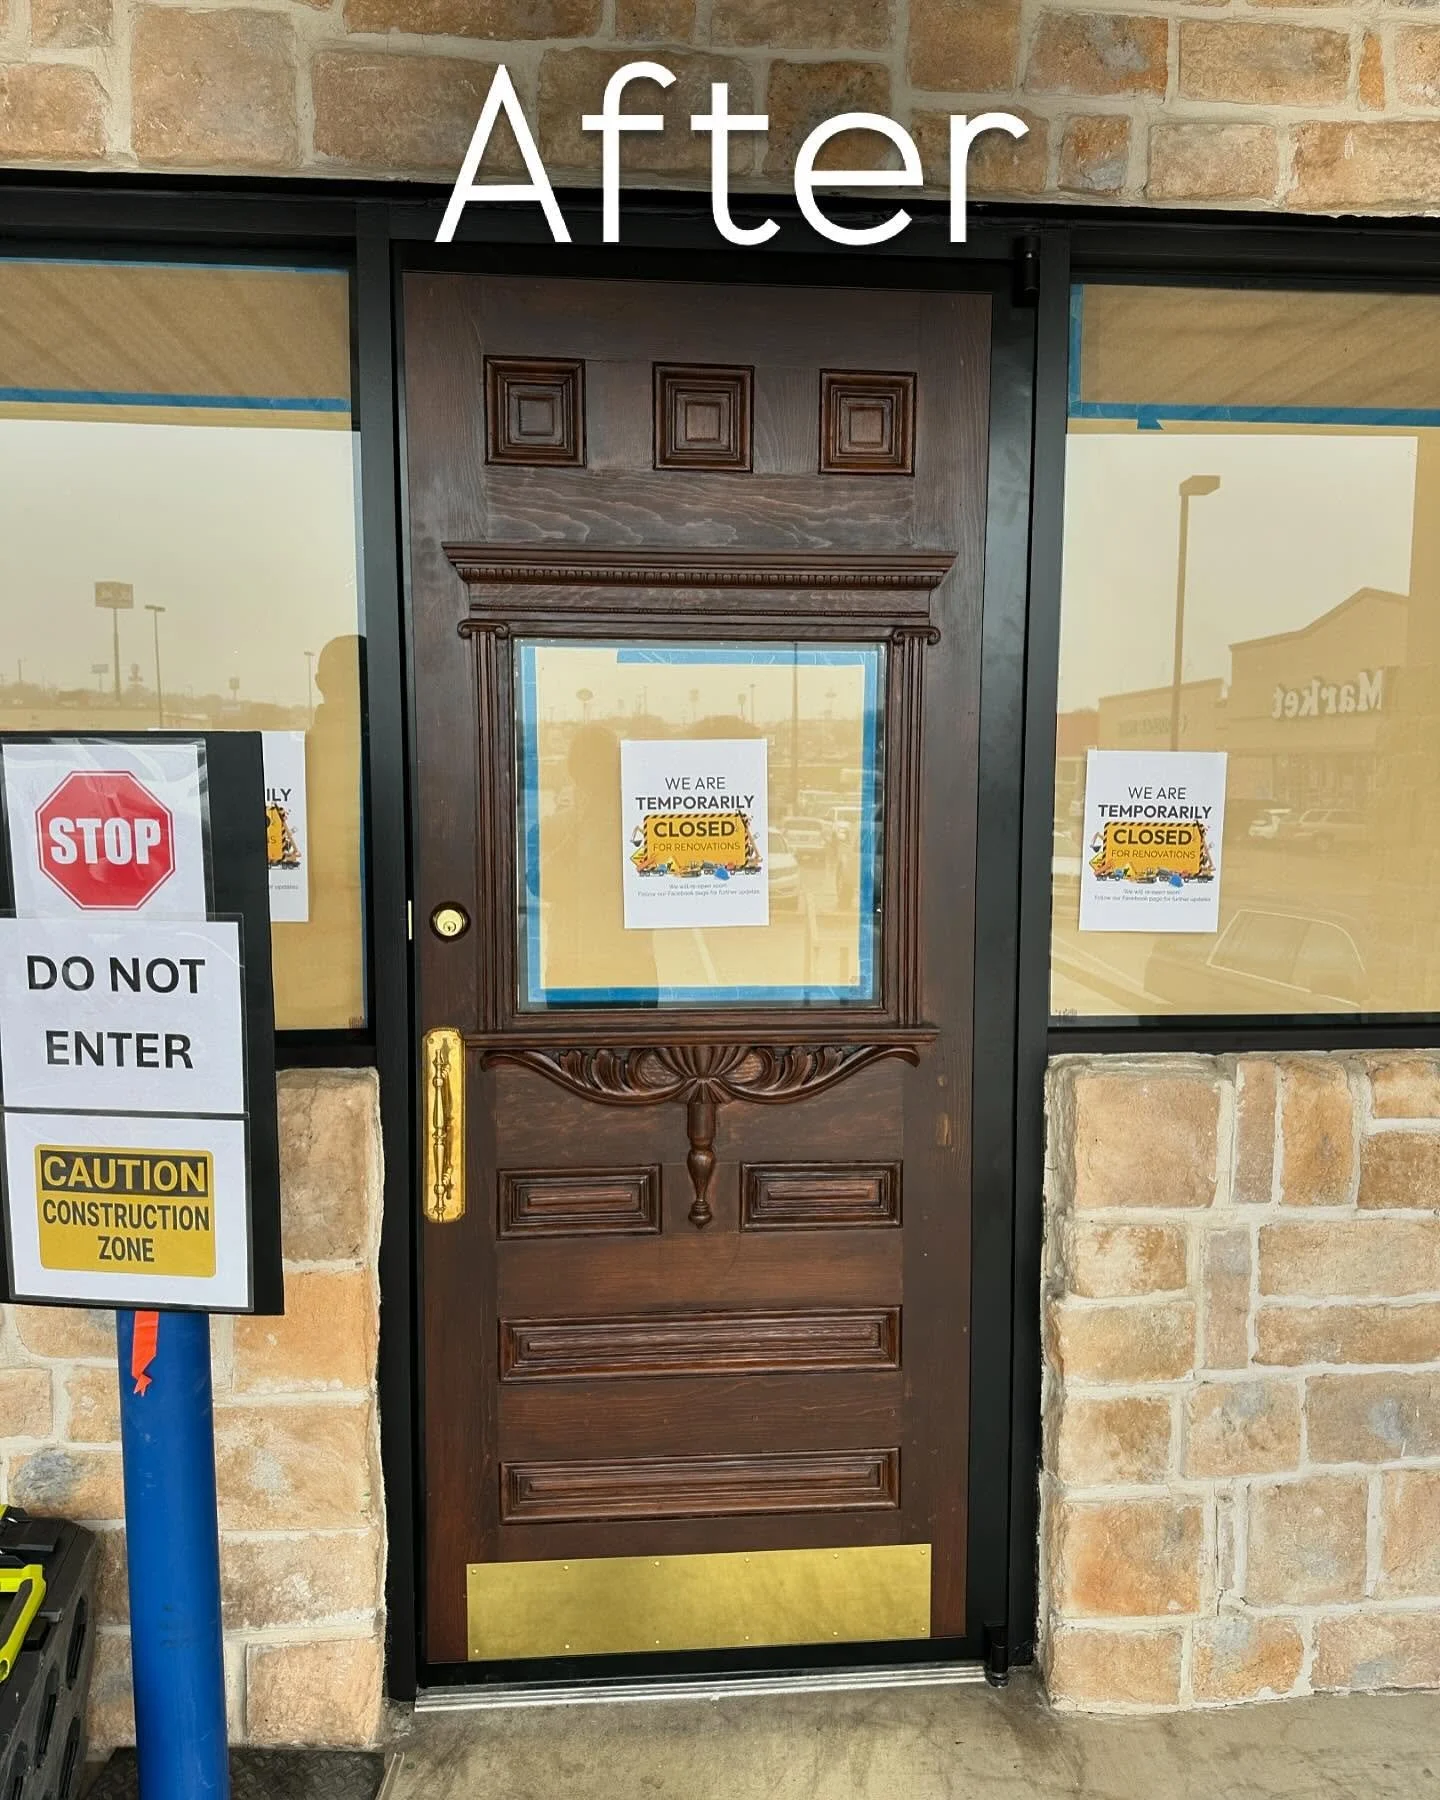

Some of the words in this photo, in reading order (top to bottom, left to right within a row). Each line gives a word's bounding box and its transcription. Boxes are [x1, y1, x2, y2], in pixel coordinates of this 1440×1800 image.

[664, 777, 691, 790] WE
[695, 777, 726, 790] ARE
[1128, 786, 1153, 800] WE
[1156, 787, 1187, 800] ARE
[635, 795, 755, 810] TEMPORARILY
[1098, 804, 1212, 819] TEMPORARILY
[653, 821, 736, 837] CLOSED
[1113, 829, 1192, 845] CLOSED
[49, 816, 162, 865] STOP
[653, 843, 672, 852] FOR
[675, 842, 741, 852] RENOVATIONS
[1111, 849, 1130, 858] FOR
[1132, 849, 1196, 859] RENOVATIONS
[27, 955, 95, 992] DO
[109, 956, 206, 994] NOT
[45, 1030, 194, 1069] ENTER
[43, 1156, 206, 1192] CAUTION
[43, 1199, 210, 1231] CONSTRUCTION
[97, 1235, 155, 1262] ZONE
